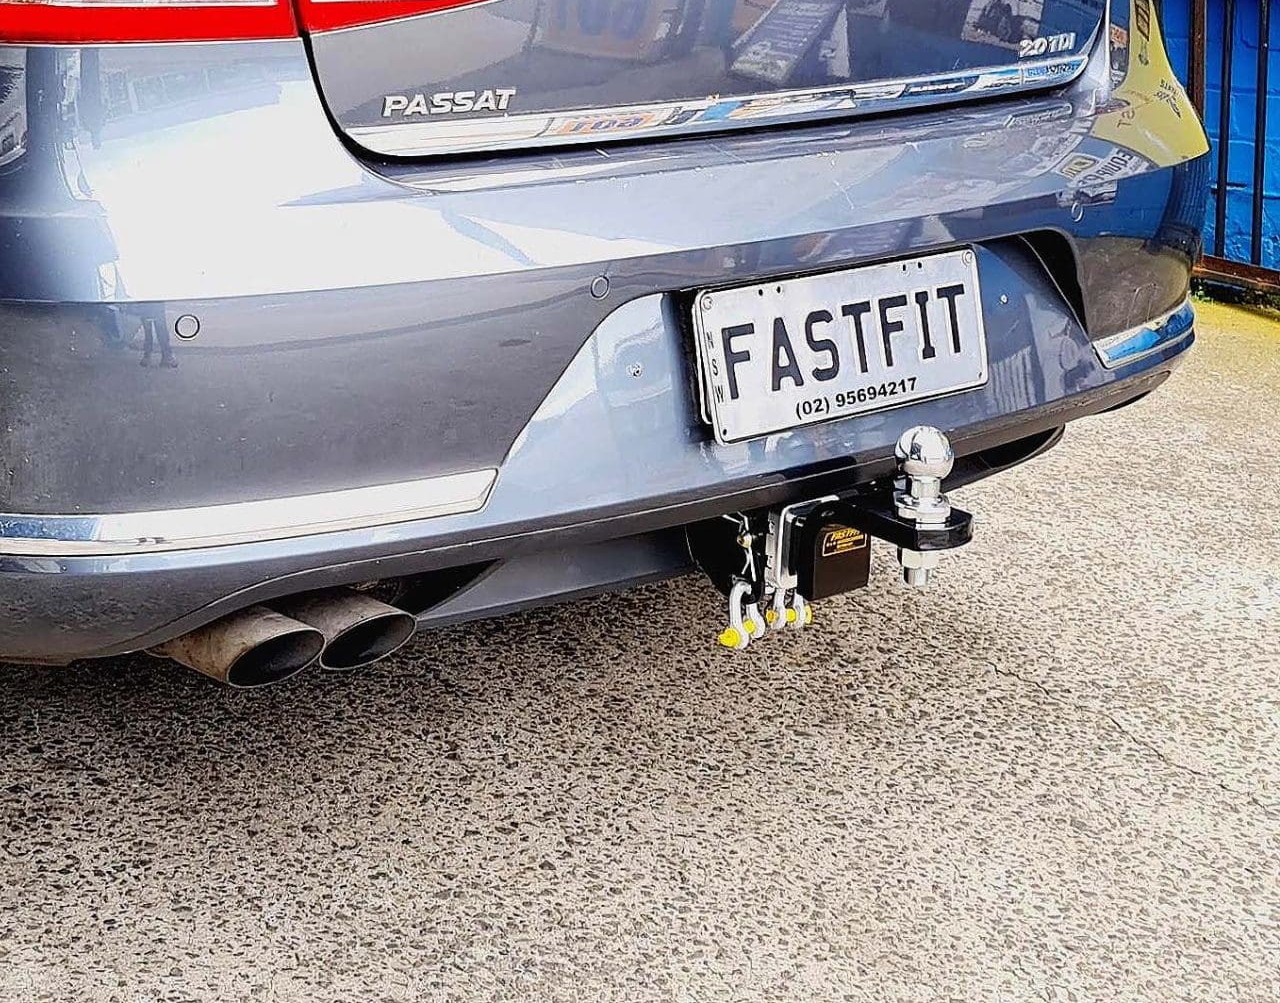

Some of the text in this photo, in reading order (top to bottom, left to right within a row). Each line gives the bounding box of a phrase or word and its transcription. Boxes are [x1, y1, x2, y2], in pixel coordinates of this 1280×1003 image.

[383, 86, 516, 118] PASSAT
[721, 283, 966, 400] FASTFIT
[795, 377, 917, 420] (02) 95694217
